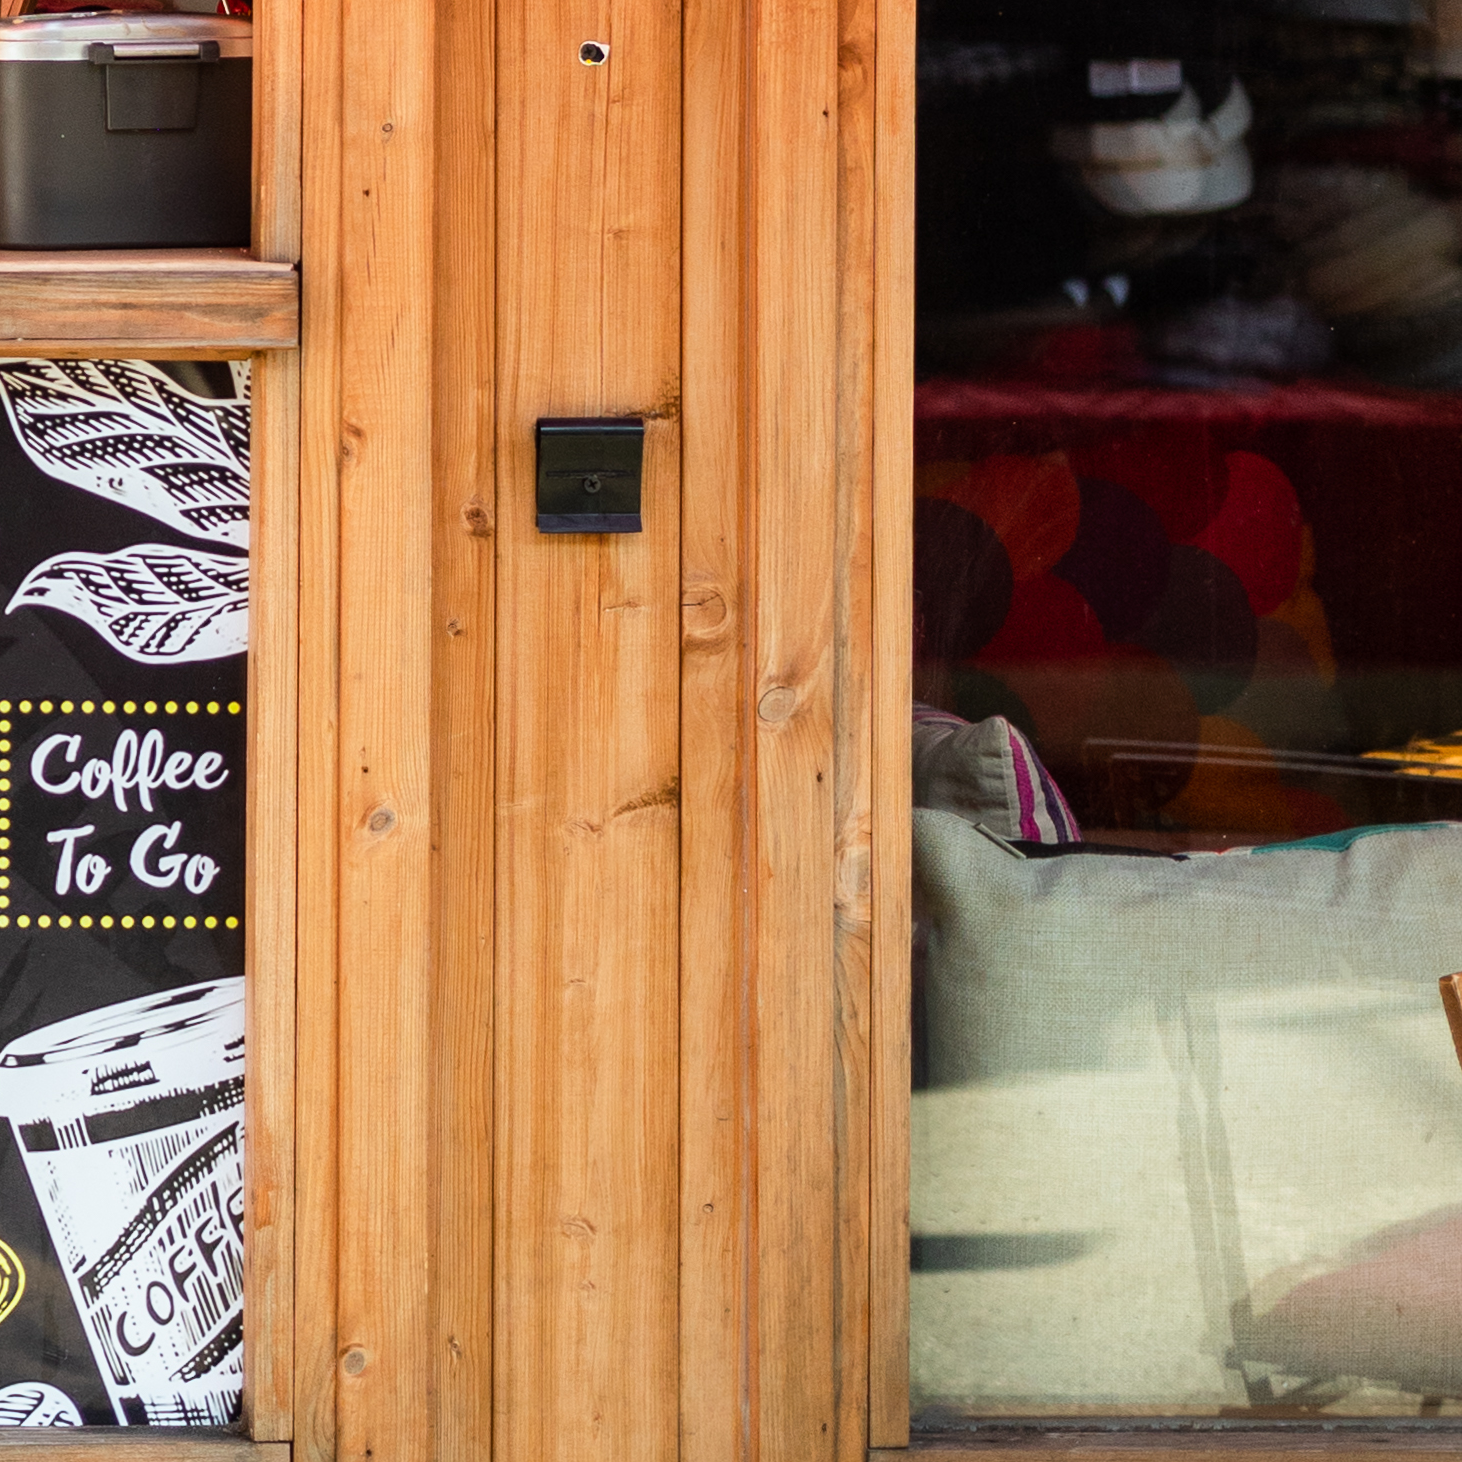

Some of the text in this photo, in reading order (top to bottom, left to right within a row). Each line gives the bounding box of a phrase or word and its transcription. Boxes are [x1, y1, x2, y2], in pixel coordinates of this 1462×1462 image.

[28, 728, 230, 814] Coffee
[46, 820, 223, 897] To Go
